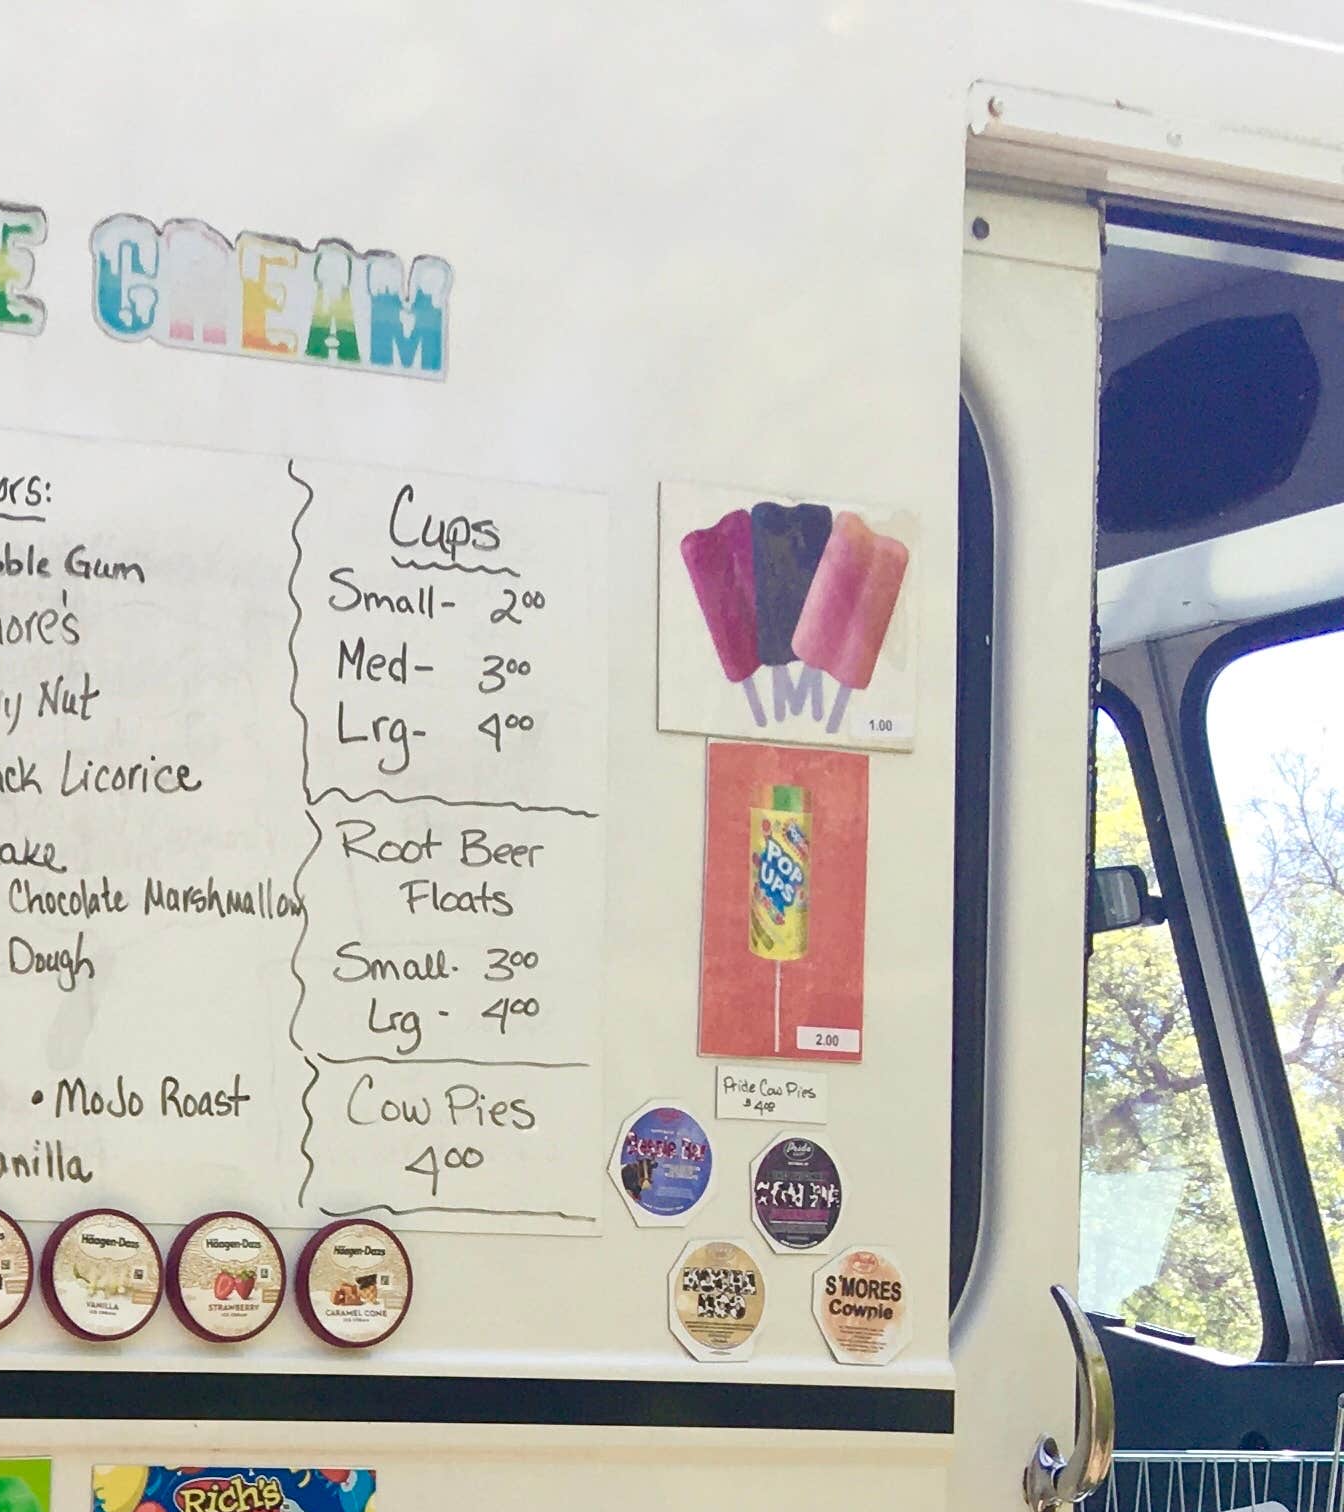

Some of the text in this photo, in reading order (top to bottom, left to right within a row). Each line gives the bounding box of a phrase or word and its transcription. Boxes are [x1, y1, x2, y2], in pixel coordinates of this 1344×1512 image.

[389, 484, 501, 562] Cups
[65, 546, 146, 584] Gum
[37, 686, 101, 719] Nut
[868, 719, 893, 732] 1.00
[61, 759, 202, 798] Licorice
[335, 819, 545, 868] Root Beer
[765, 839, 804, 884] POP
[8, 875, 308, 920] Chocolate Marshmallow
[399, 879, 514, 917] Floats
[760, 861, 795, 903] UPS
[10, 931, 96, 992] Dough
[368, 997, 423, 1056] Lrg
[815, 1033, 839, 1048] 2.00
[160, 1075, 252, 1119] Roast
[348, 1073, 537, 1131] Cow Pies
[723, 1075, 817, 1099] Pride Cow Pies
[86, 1301, 120, 1311] VANILLA
[825, 1274, 903, 1302] S'MORES
[207, 1303, 260, 1312] STRAWBERRY
[325, 1309, 388, 1317] CARAMEL CONE
[828, 1298, 894, 1321] Cownie
